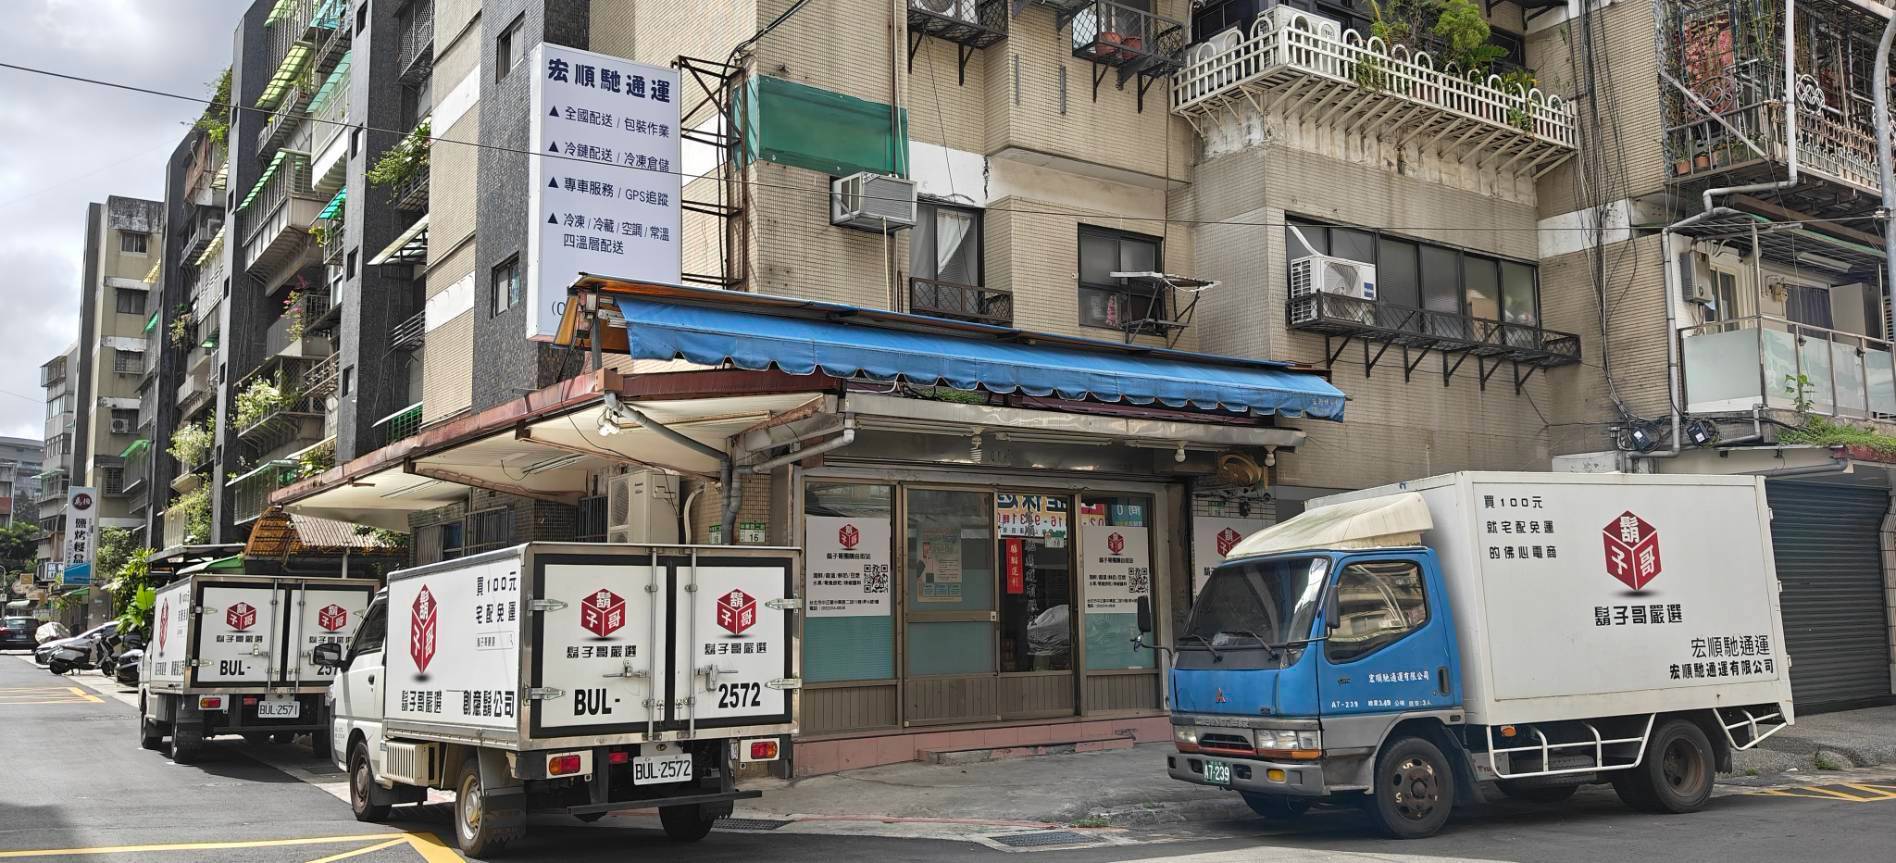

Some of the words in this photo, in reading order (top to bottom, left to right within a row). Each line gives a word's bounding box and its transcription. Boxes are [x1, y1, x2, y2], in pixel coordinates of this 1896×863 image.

[548, 58, 671, 103] 宏順馳通運
[565, 106, 613, 128] 全國配送
[624, 118, 670, 139] 包裝作業
[624, 152, 670, 173] 冷凍倉儲
[564, 177, 614, 198] 專車服務
[625, 188, 669, 207] GPS追蹤
[563, 233, 624, 255] 四溫層配送
[1484, 495, 1543, 509] 買100元
[1487, 520, 1555, 534] 就宅配免運
[1489, 545, 1557, 560] 的佛心電商
[1595, 603, 1683, 627] 鬍子哥嚴選
[567, 645, 637, 659] 鬍子哥嚴選
[704, 642, 767, 655] 鬍子哥嚴選
[1691, 634, 1770, 658] 宏順馳通運
[1669, 658, 1774, 680] 宏順馳通運有限公司
[574, 688, 621, 716] BUL-
[718, 682, 761, 709] 2572
